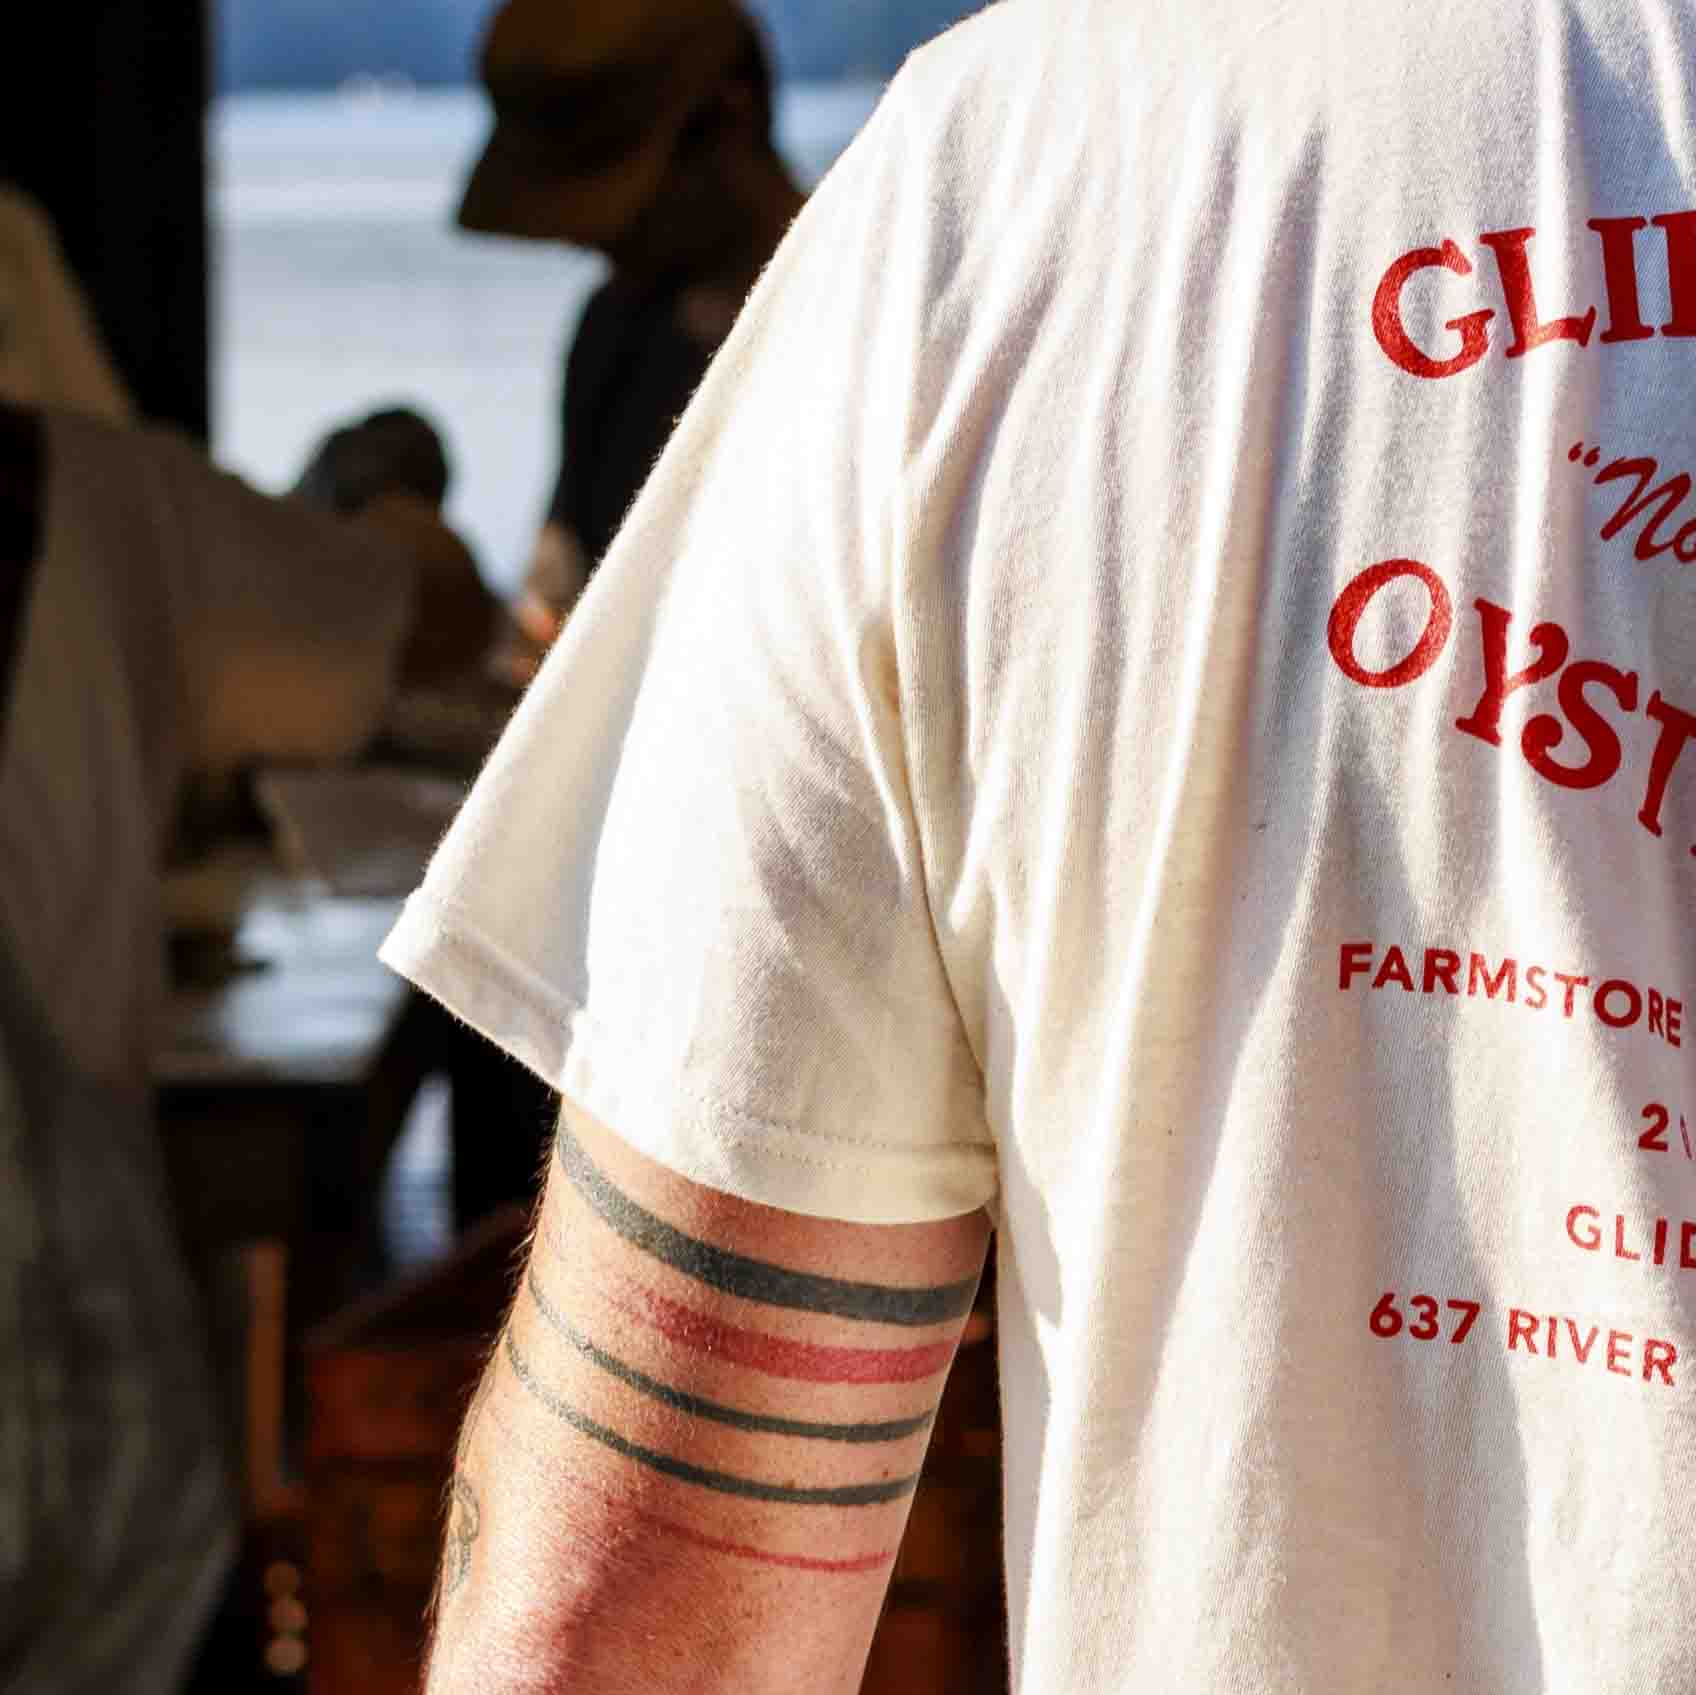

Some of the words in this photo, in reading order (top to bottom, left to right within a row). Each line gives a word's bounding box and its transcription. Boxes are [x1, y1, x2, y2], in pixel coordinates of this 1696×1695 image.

[1338, 942, 1683, 1049] FARMSTORE
[1368, 1290, 1482, 1345] 637
[1507, 1308, 1678, 1386] RIVER
